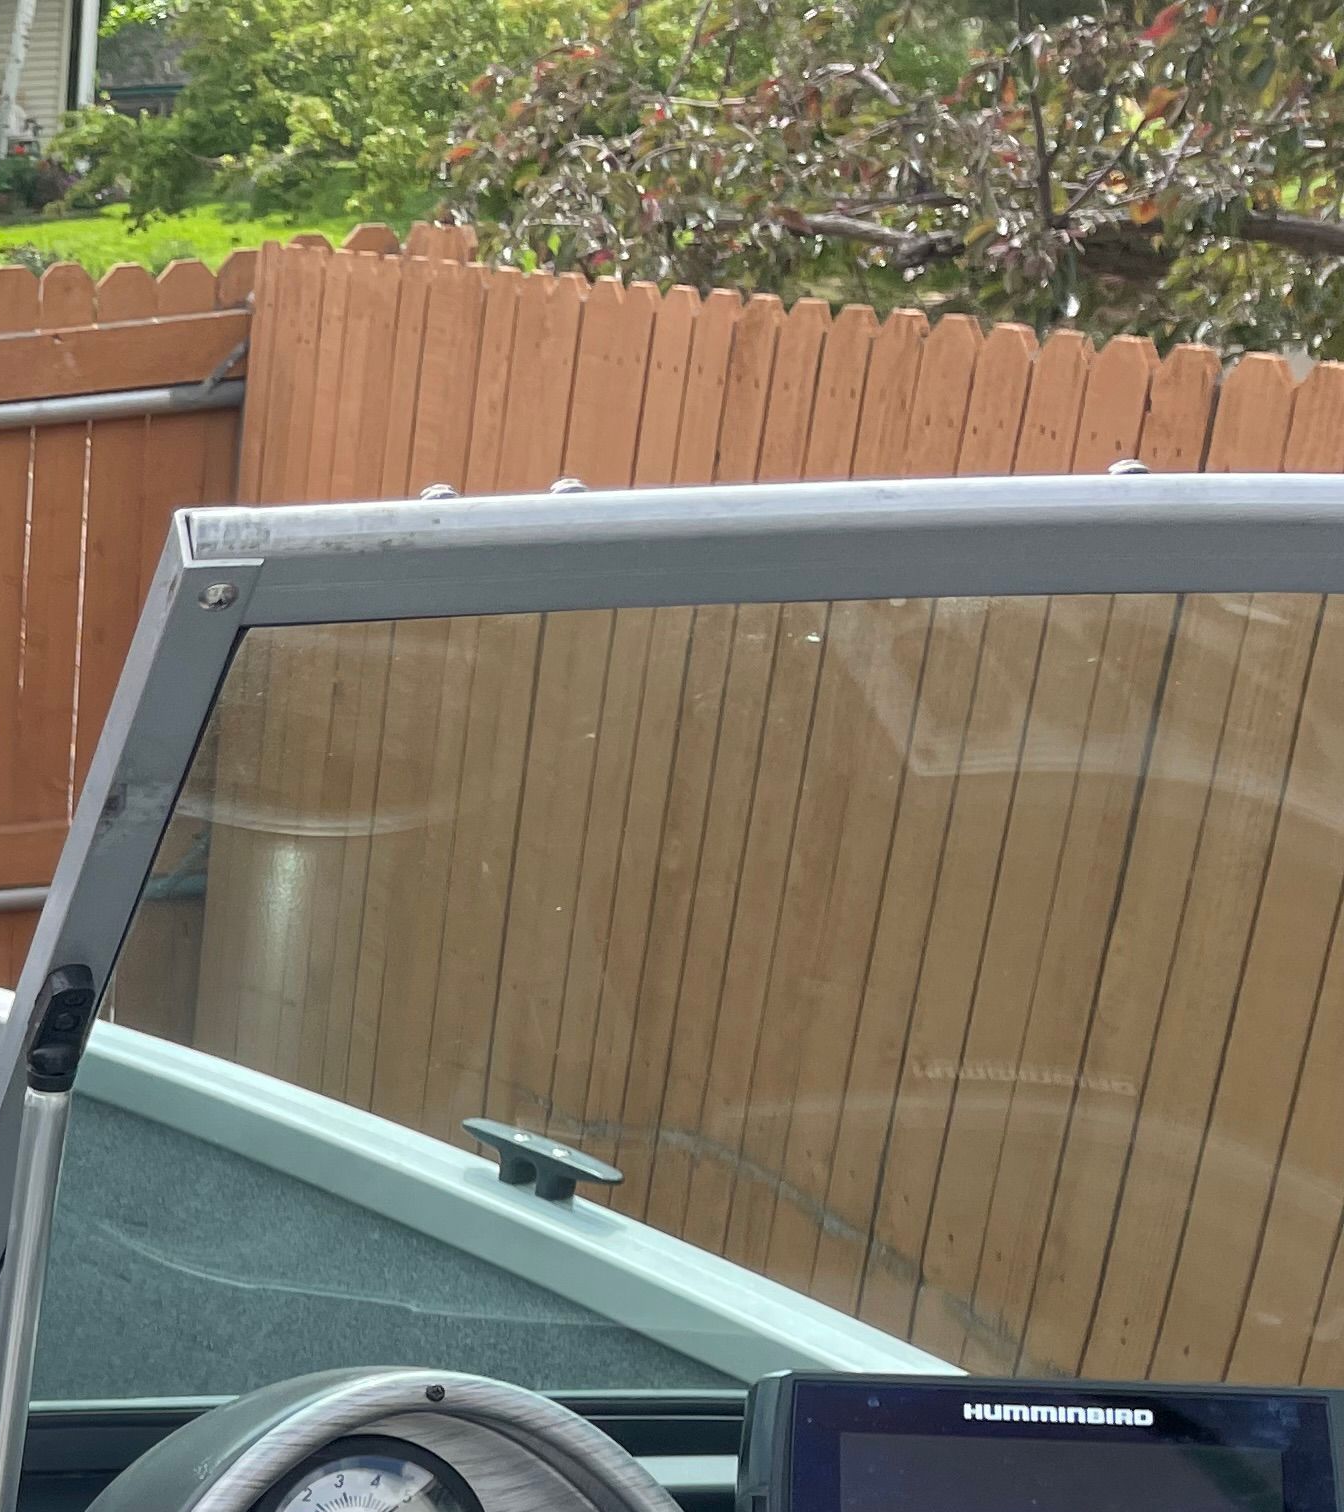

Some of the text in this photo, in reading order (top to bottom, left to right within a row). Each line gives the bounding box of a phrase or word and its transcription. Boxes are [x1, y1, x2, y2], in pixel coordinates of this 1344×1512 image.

[963, 1403, 1154, 1427] HUMMINBIRD
[301, 1488, 312, 1502] 2
[334, 1474, 345, 1488] 3
[370, 1473, 383, 1488] 4
